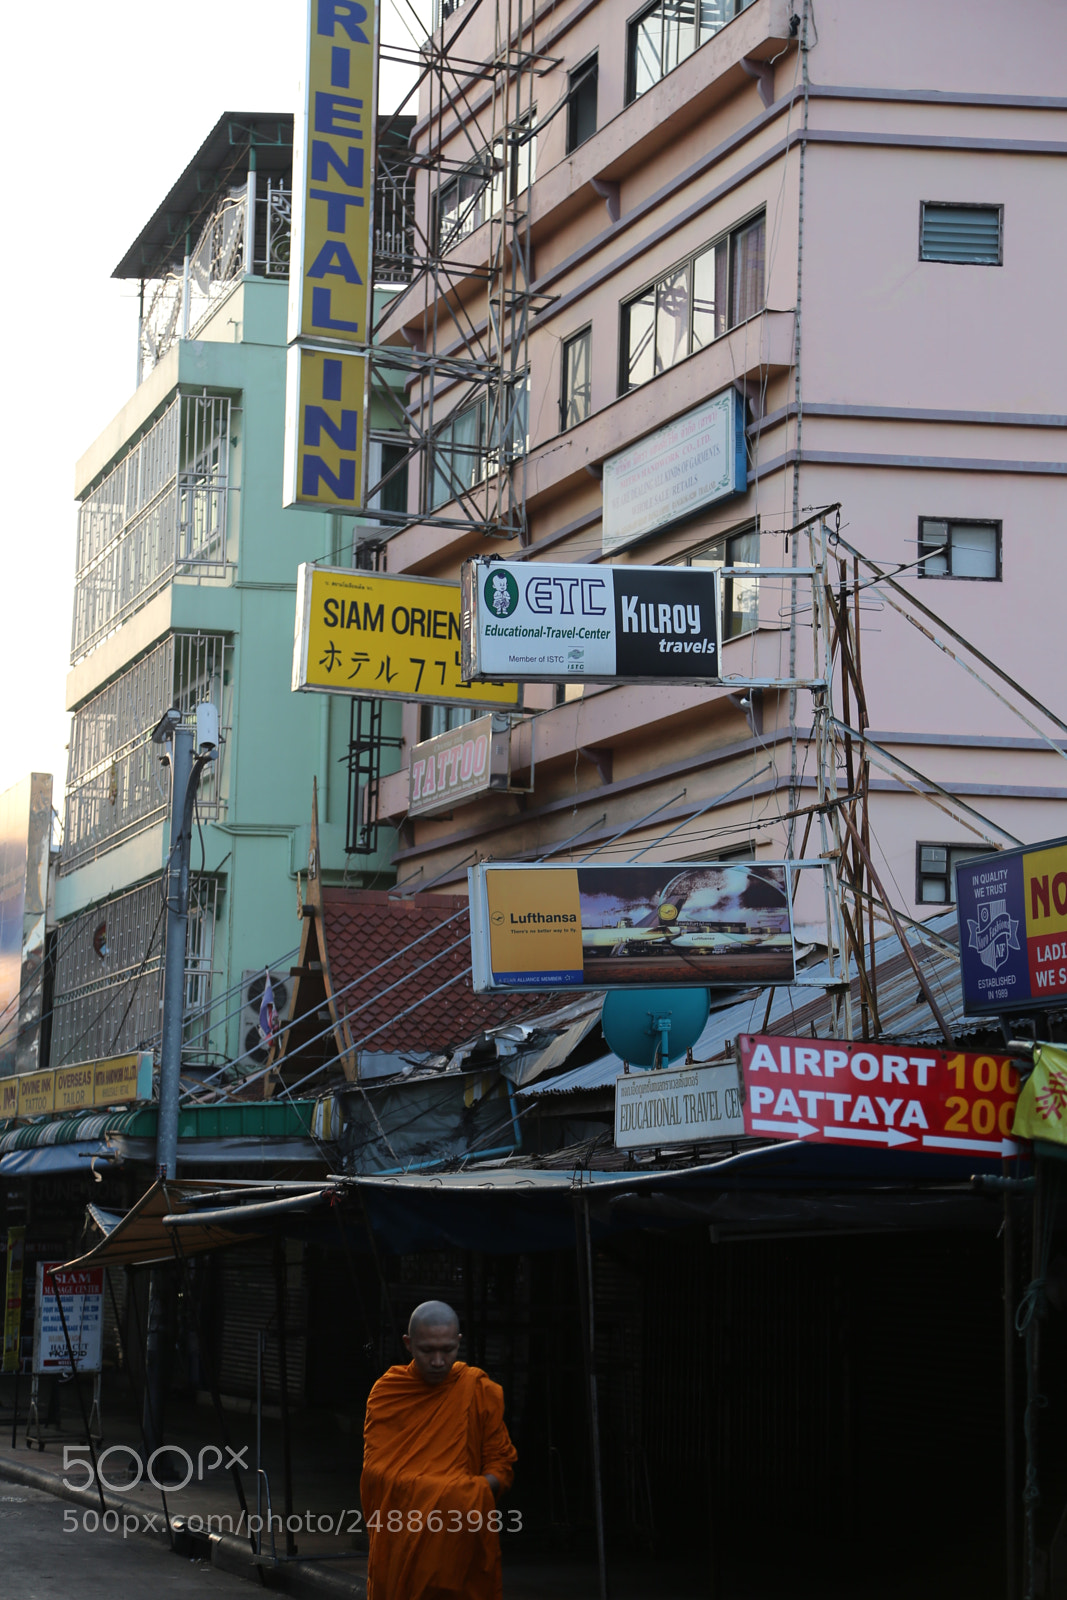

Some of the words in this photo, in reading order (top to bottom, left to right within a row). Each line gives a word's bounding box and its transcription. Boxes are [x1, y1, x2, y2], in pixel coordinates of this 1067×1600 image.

[306, 0, 371, 333] RIENTAL
[302, 359, 357, 501] INN
[525, 576, 607, 616] ETC
[323, 597, 385, 633] SIAM
[391, 605, 462, 641] ORIEN
[620, 595, 701, 635] KILROY
[658, 638, 716, 654] travels
[318, 640, 399, 685] ホテル
[508, 655, 537, 663] Member
[538, 655, 545, 663] of
[546, 655, 565, 664] ISTC
[412, 734, 488, 801] TATTOO
[972, 875, 980, 887] IN
[979, 869, 1009, 884] QUALITY
[974, 887, 986, 898] WE
[985, 882, 1008, 897] TRUST
[510, 912, 577, 924] Lufthansa
[995, 943, 1006, 958] NF
[1036, 941, 1067, 962] LADI
[977, 974, 1017, 989] ESTABLISHED
[1035, 969, 1056, 988] WE
[987, 990, 995, 1000] IN
[749, 1043, 936, 1086] AIRPORT
[946, 1054, 1020, 1095] 100
[58, 1070, 92, 1090] OVERSEAS
[25, 1095, 47, 1111] TATTOO
[63, 1089, 85, 1106] TAILOR
[619, 1095, 682, 1133] EDUCATIONAL
[683, 1090, 722, 1124] TRAVEL
[749, 1085, 930, 1130] PATTAYA
[54, 1272, 91, 1284] SIAM
[45, 1285, 73, 1294] MASAGE
